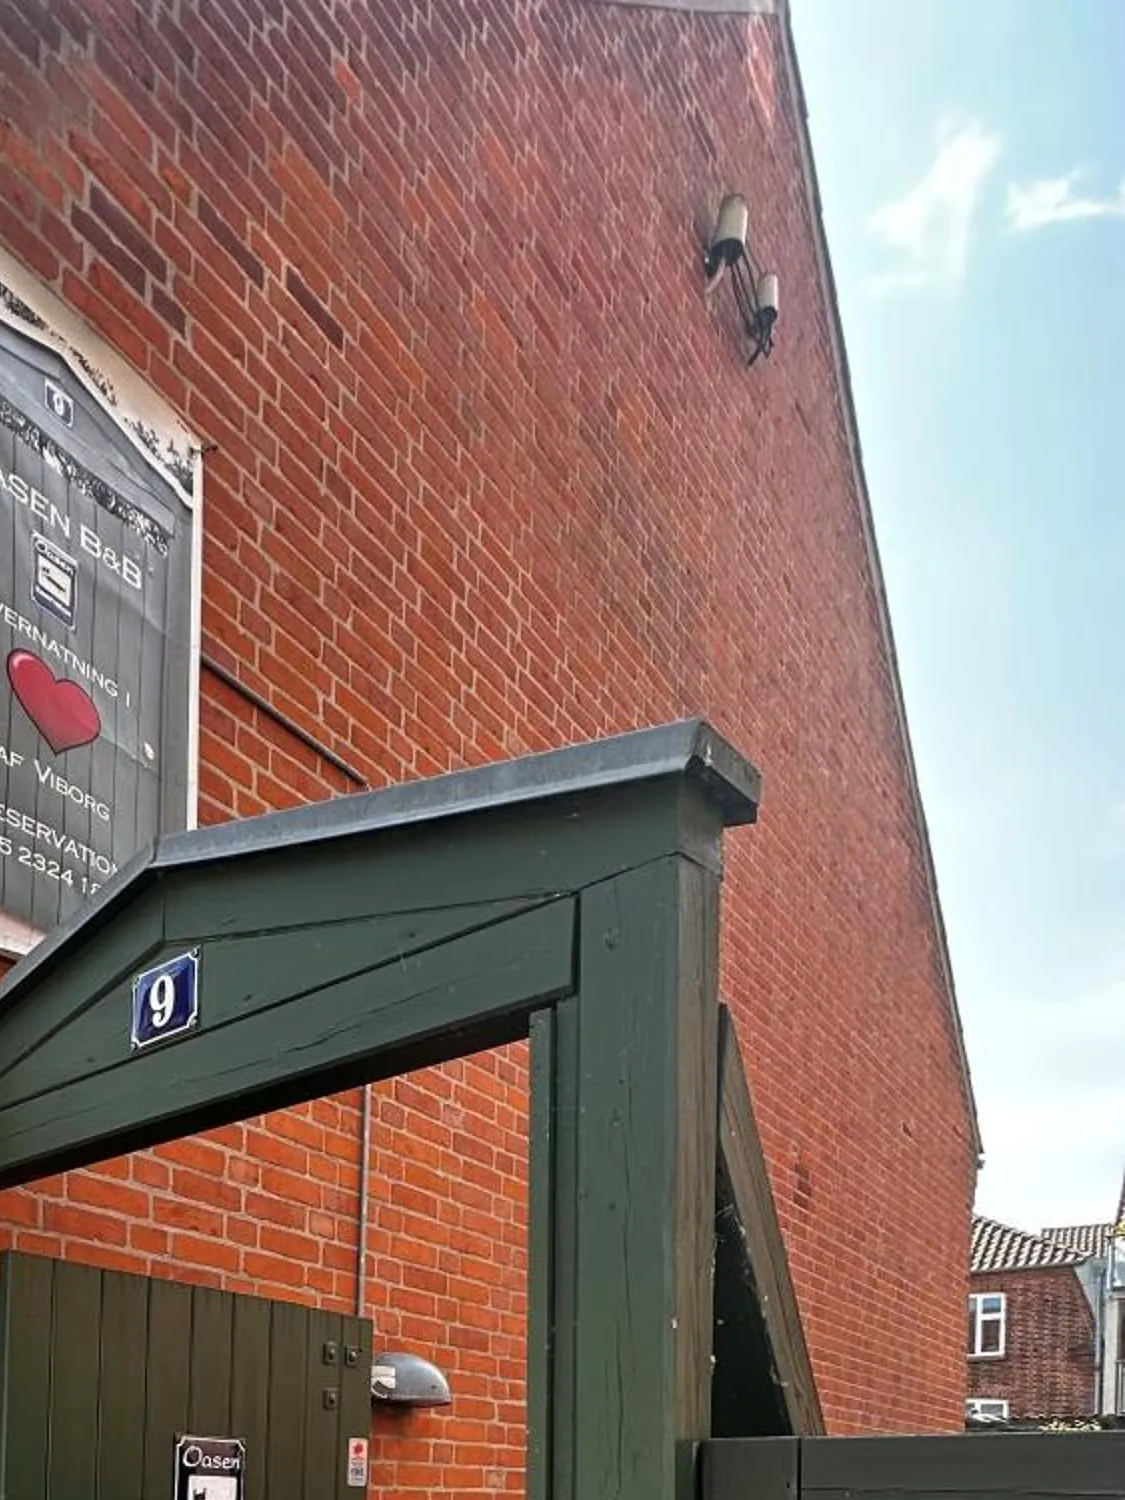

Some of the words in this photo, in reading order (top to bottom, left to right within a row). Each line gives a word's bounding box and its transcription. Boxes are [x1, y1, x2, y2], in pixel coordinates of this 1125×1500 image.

[79, 523, 142, 590] B&B
[125, 691, 131, 708] I
[34, 758, 111, 822] VIBORG
[18, 846, 74, 886] 2324
[149, 975, 176, 1029] 9
[182, 1445, 240, 1470] Oasen
